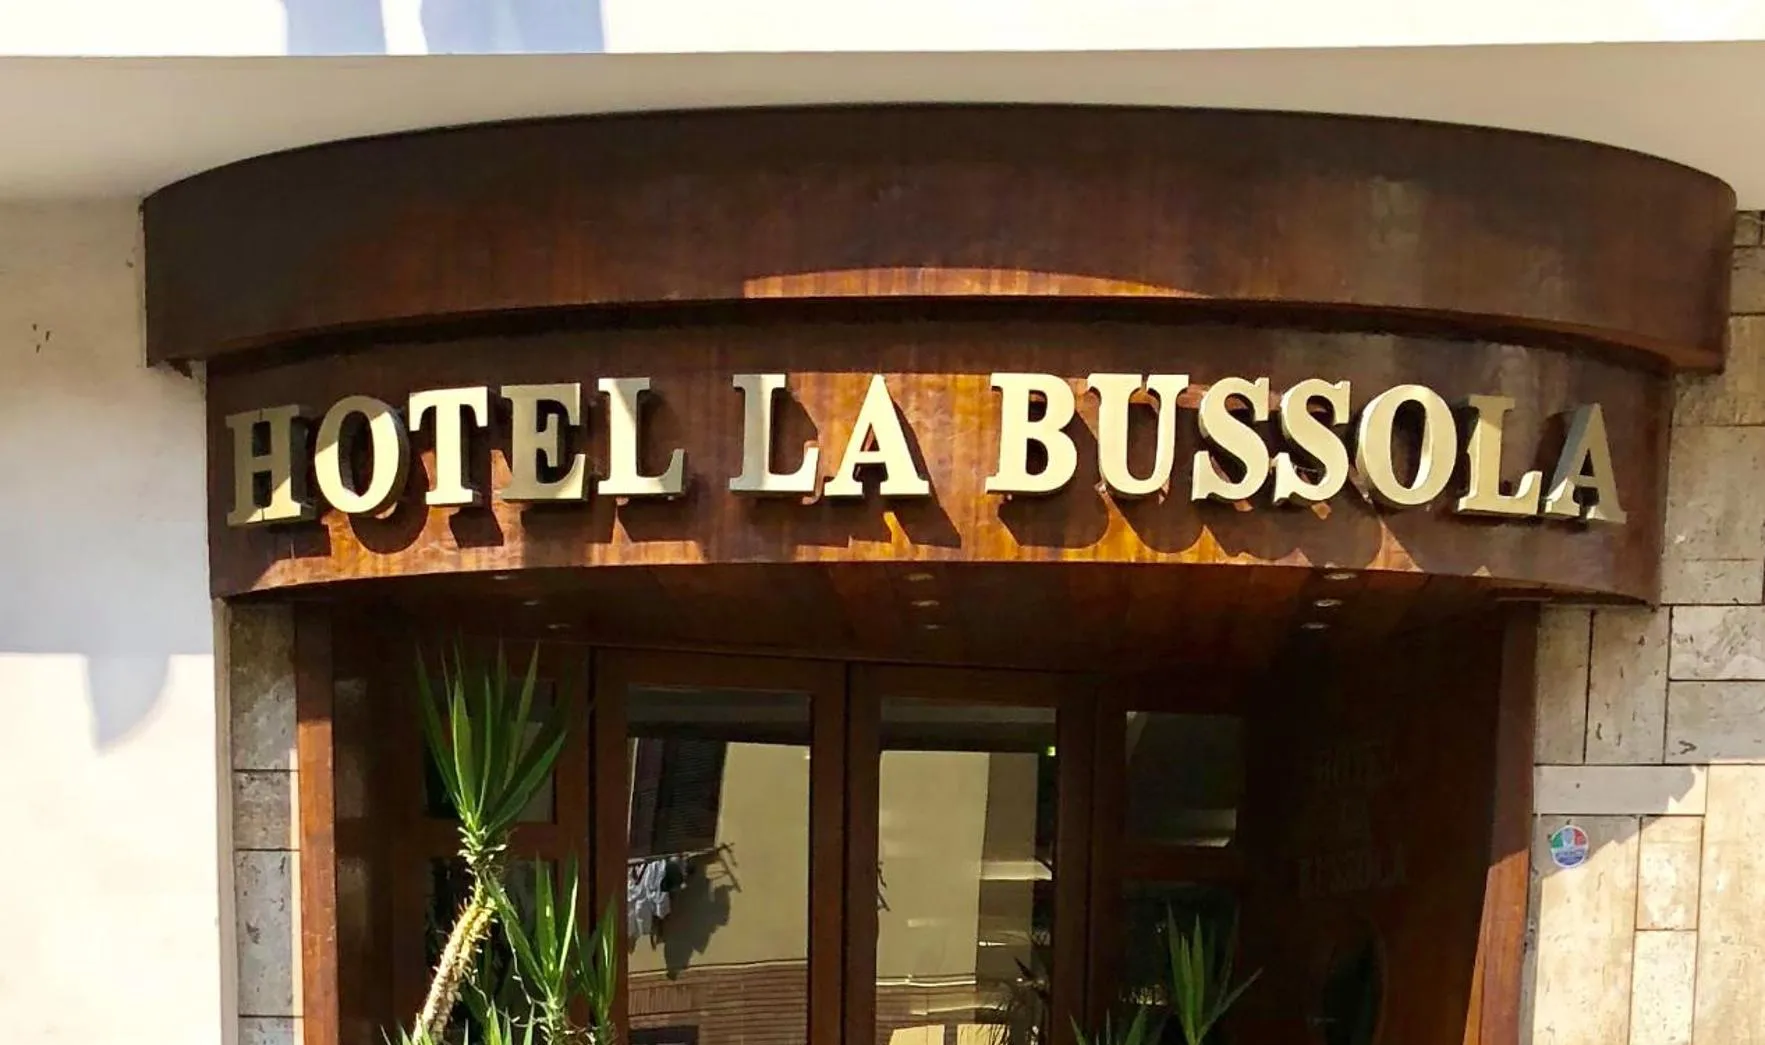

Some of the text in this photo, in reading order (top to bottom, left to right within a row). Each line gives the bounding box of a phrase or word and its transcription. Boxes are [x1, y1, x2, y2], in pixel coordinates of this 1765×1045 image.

[226, 372, 1628, 527] HOTEL LA BUSSOLA
